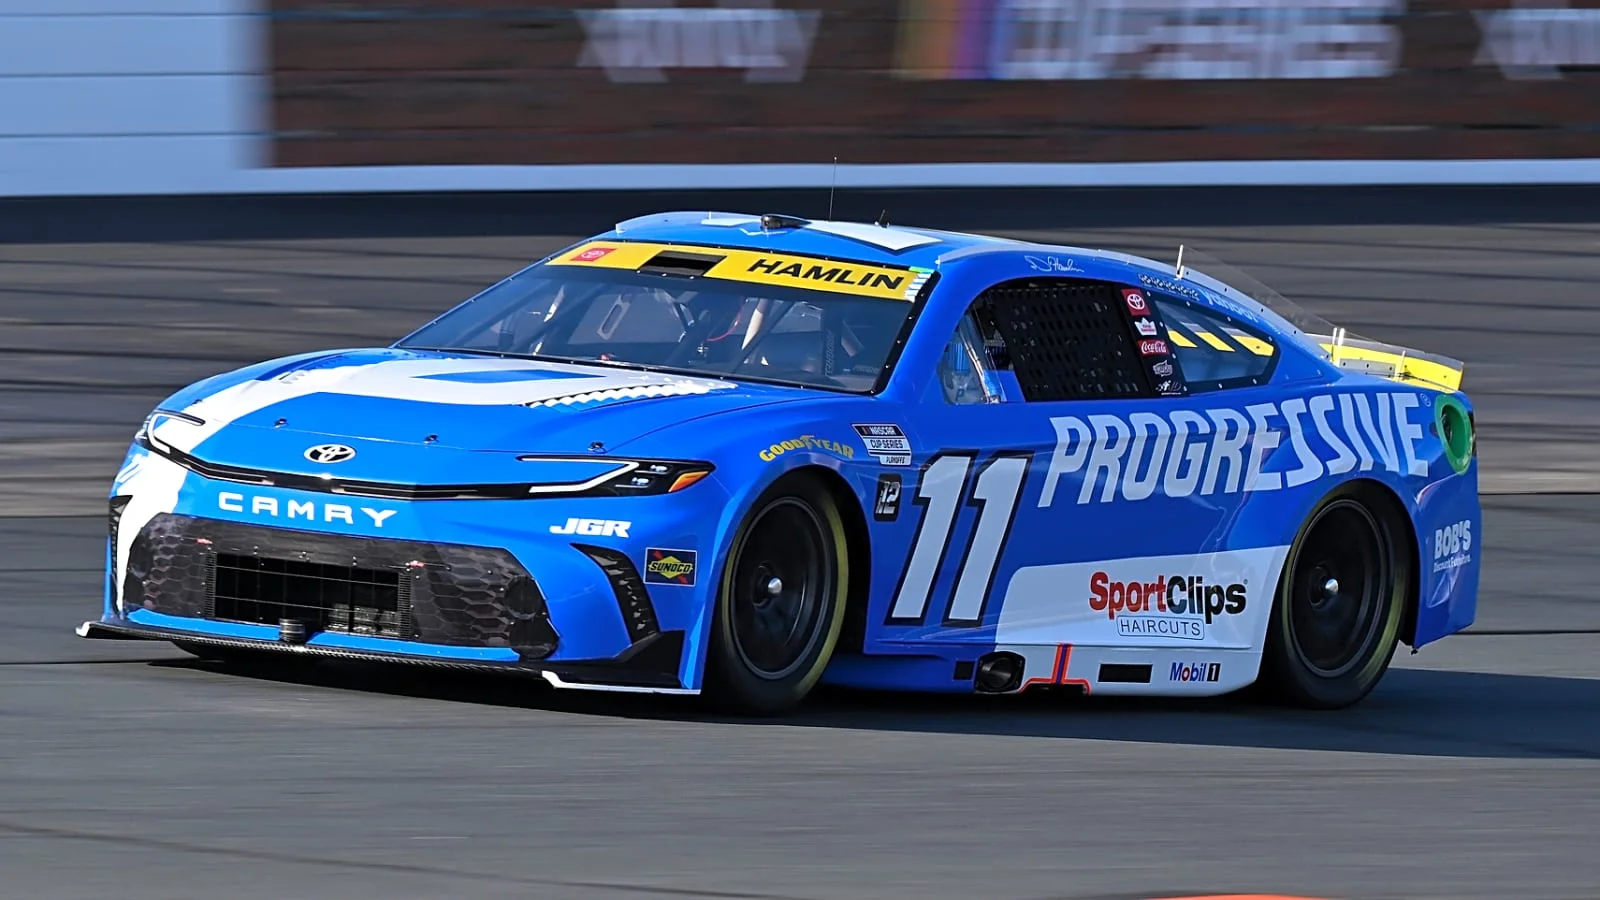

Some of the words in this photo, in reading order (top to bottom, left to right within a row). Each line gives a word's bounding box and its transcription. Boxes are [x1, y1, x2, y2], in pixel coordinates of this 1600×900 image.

[747, 258, 905, 290] HAMLIN
[869, 426, 897, 435] NASCAR
[759, 434, 854, 462] GOODYEAR
[870, 439, 883, 448] CUP
[883, 439, 904, 449] SERIES
[1037, 392, 1430, 508] PROGRESSIVE
[218, 491, 398, 528] CAMRY
[549, 517, 632, 538] JGR
[884, 448, 1035, 627] 11
[1434, 519, 1472, 560] BOB'S
[649, 562, 692, 574] SUNOCO
[1119, 618, 1201, 636] HAIRCUTS
[1169, 662, 1207, 682] Mobil
